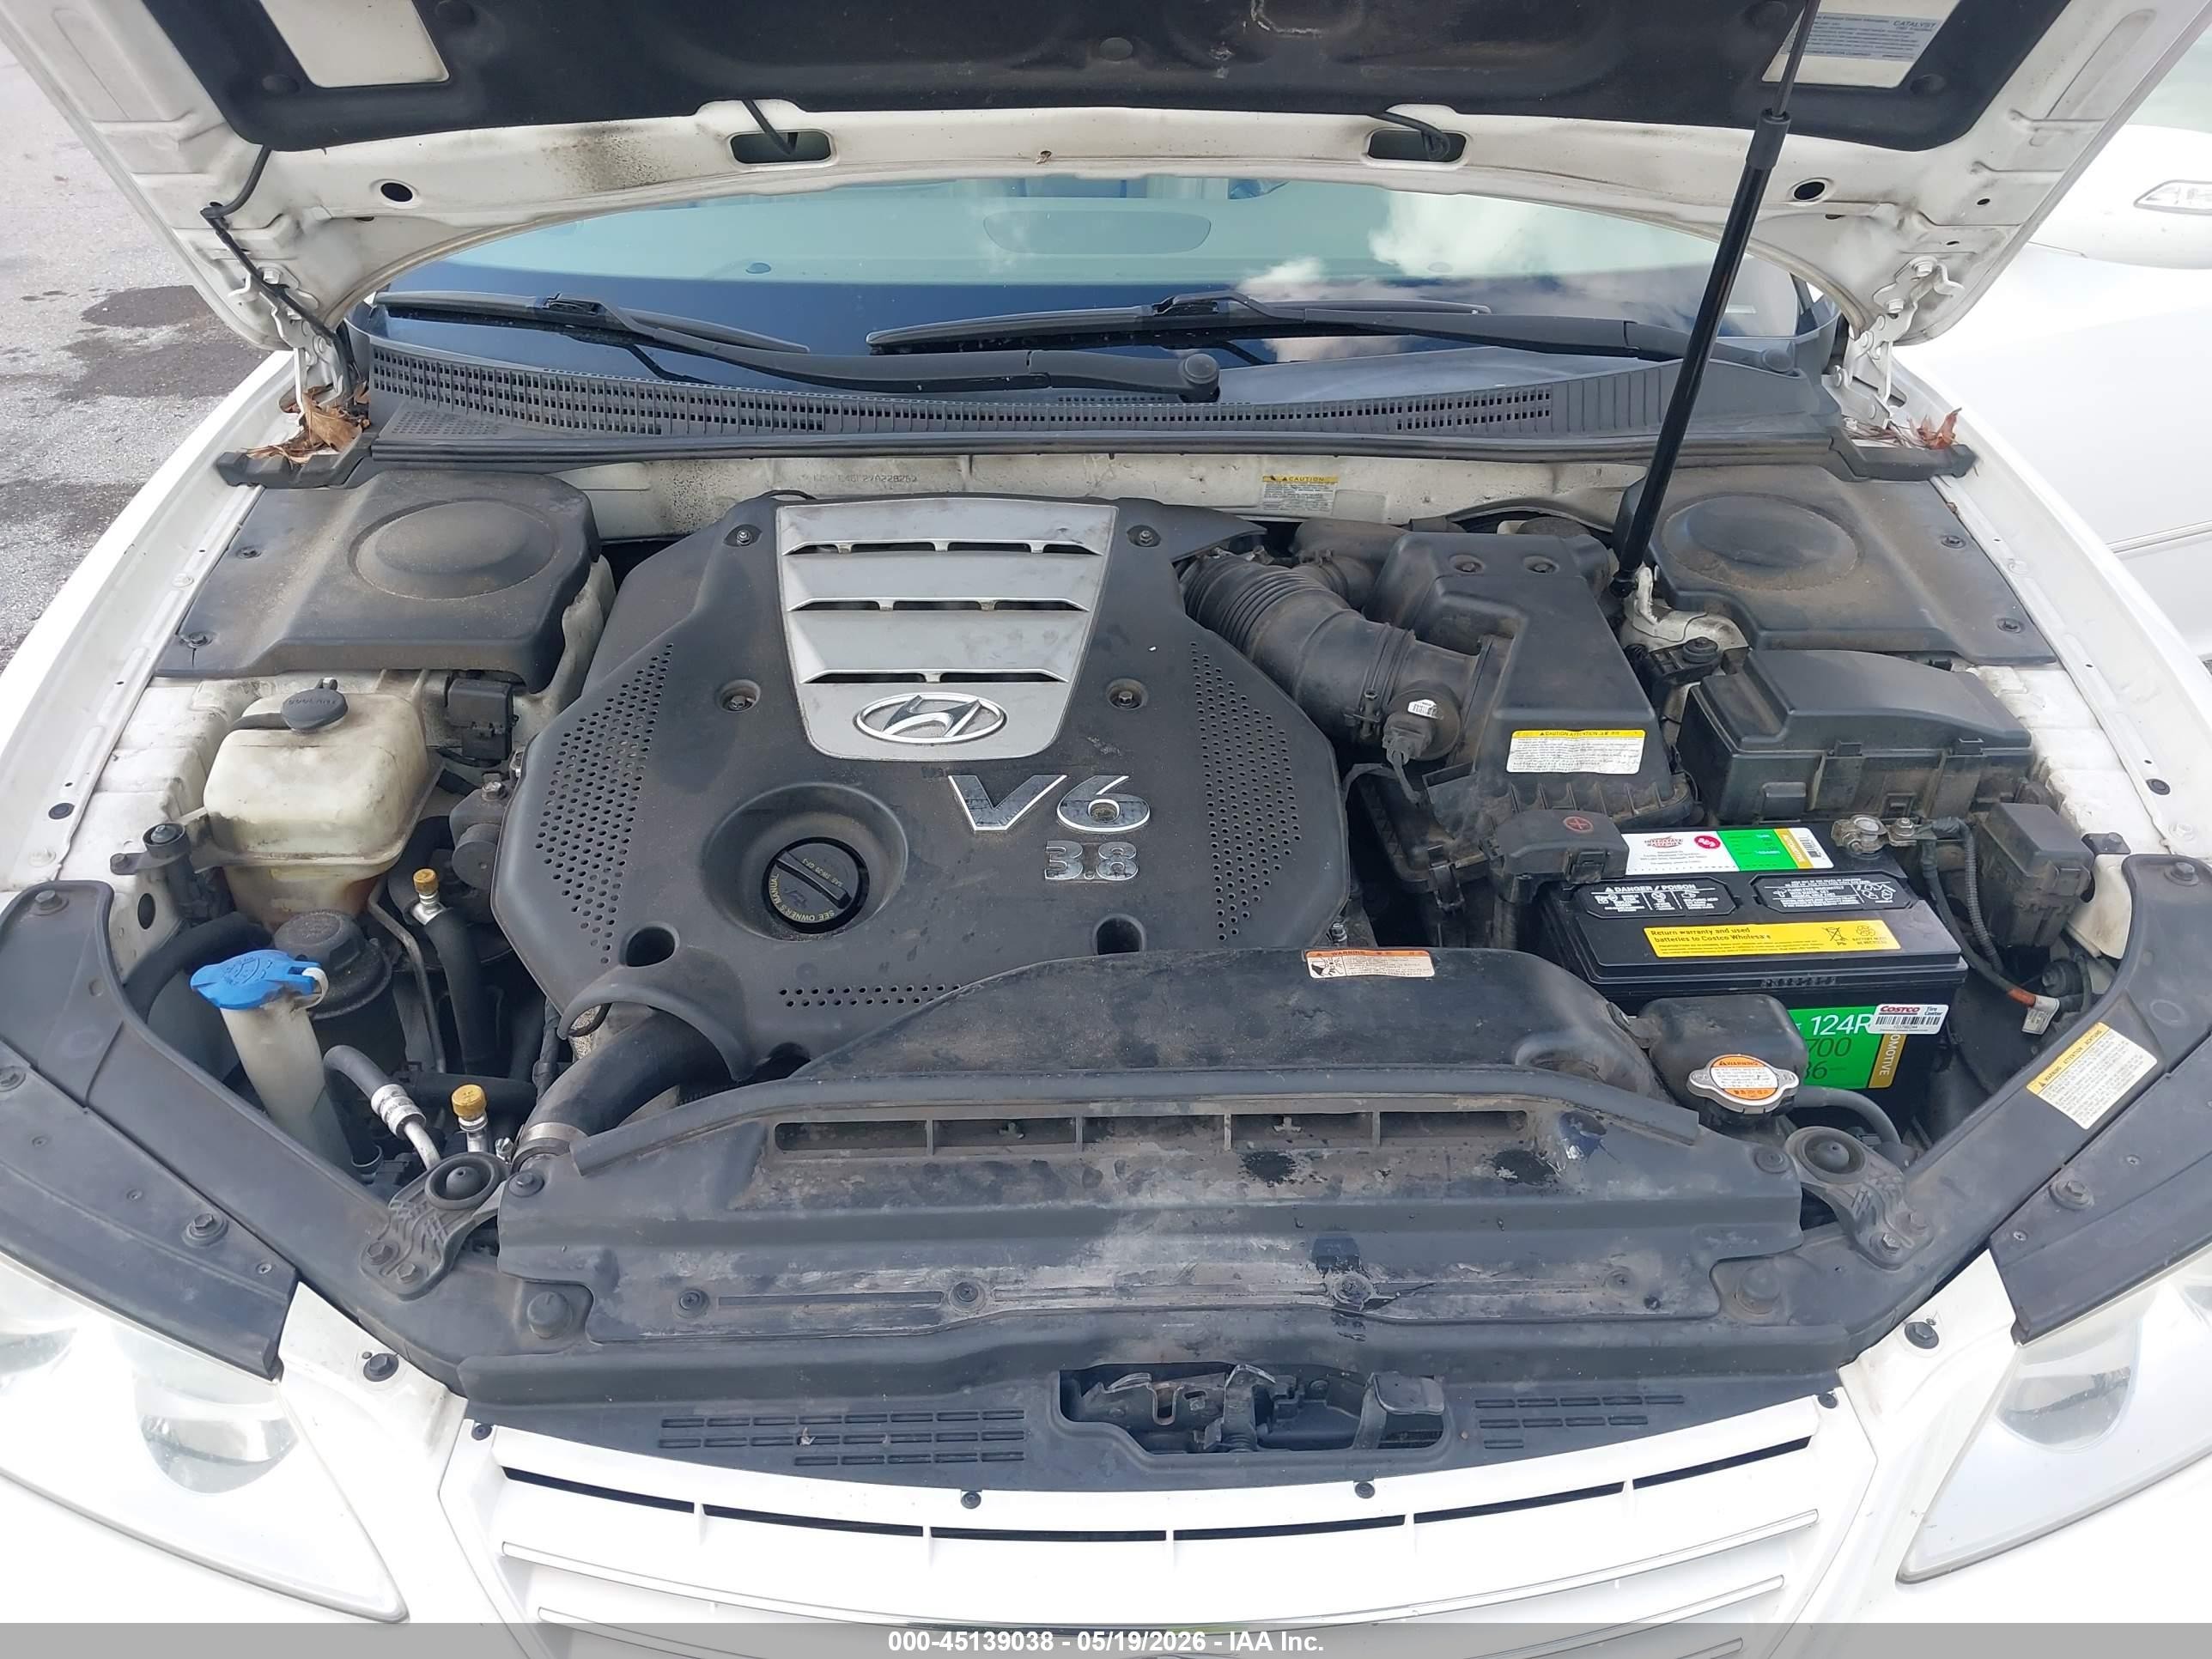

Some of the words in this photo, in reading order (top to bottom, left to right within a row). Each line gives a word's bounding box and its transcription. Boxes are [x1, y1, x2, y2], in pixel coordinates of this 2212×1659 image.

[948, 775, 1151, 832] V6
[1044, 841, 1139, 881] 3.8
[769, 873, 782, 904] MANUAL
[781, 904, 816, 921] OWNER'S
[818, 909, 836, 921] SEE
[1650, 928, 1678, 937] Return
[1679, 928, 1714, 937] warranty
[1655, 934, 1692, 943] batteries
[1810, 1014, 1874, 1036] 124R
[1879, 1033, 1901, 1076] OMOTIVE
